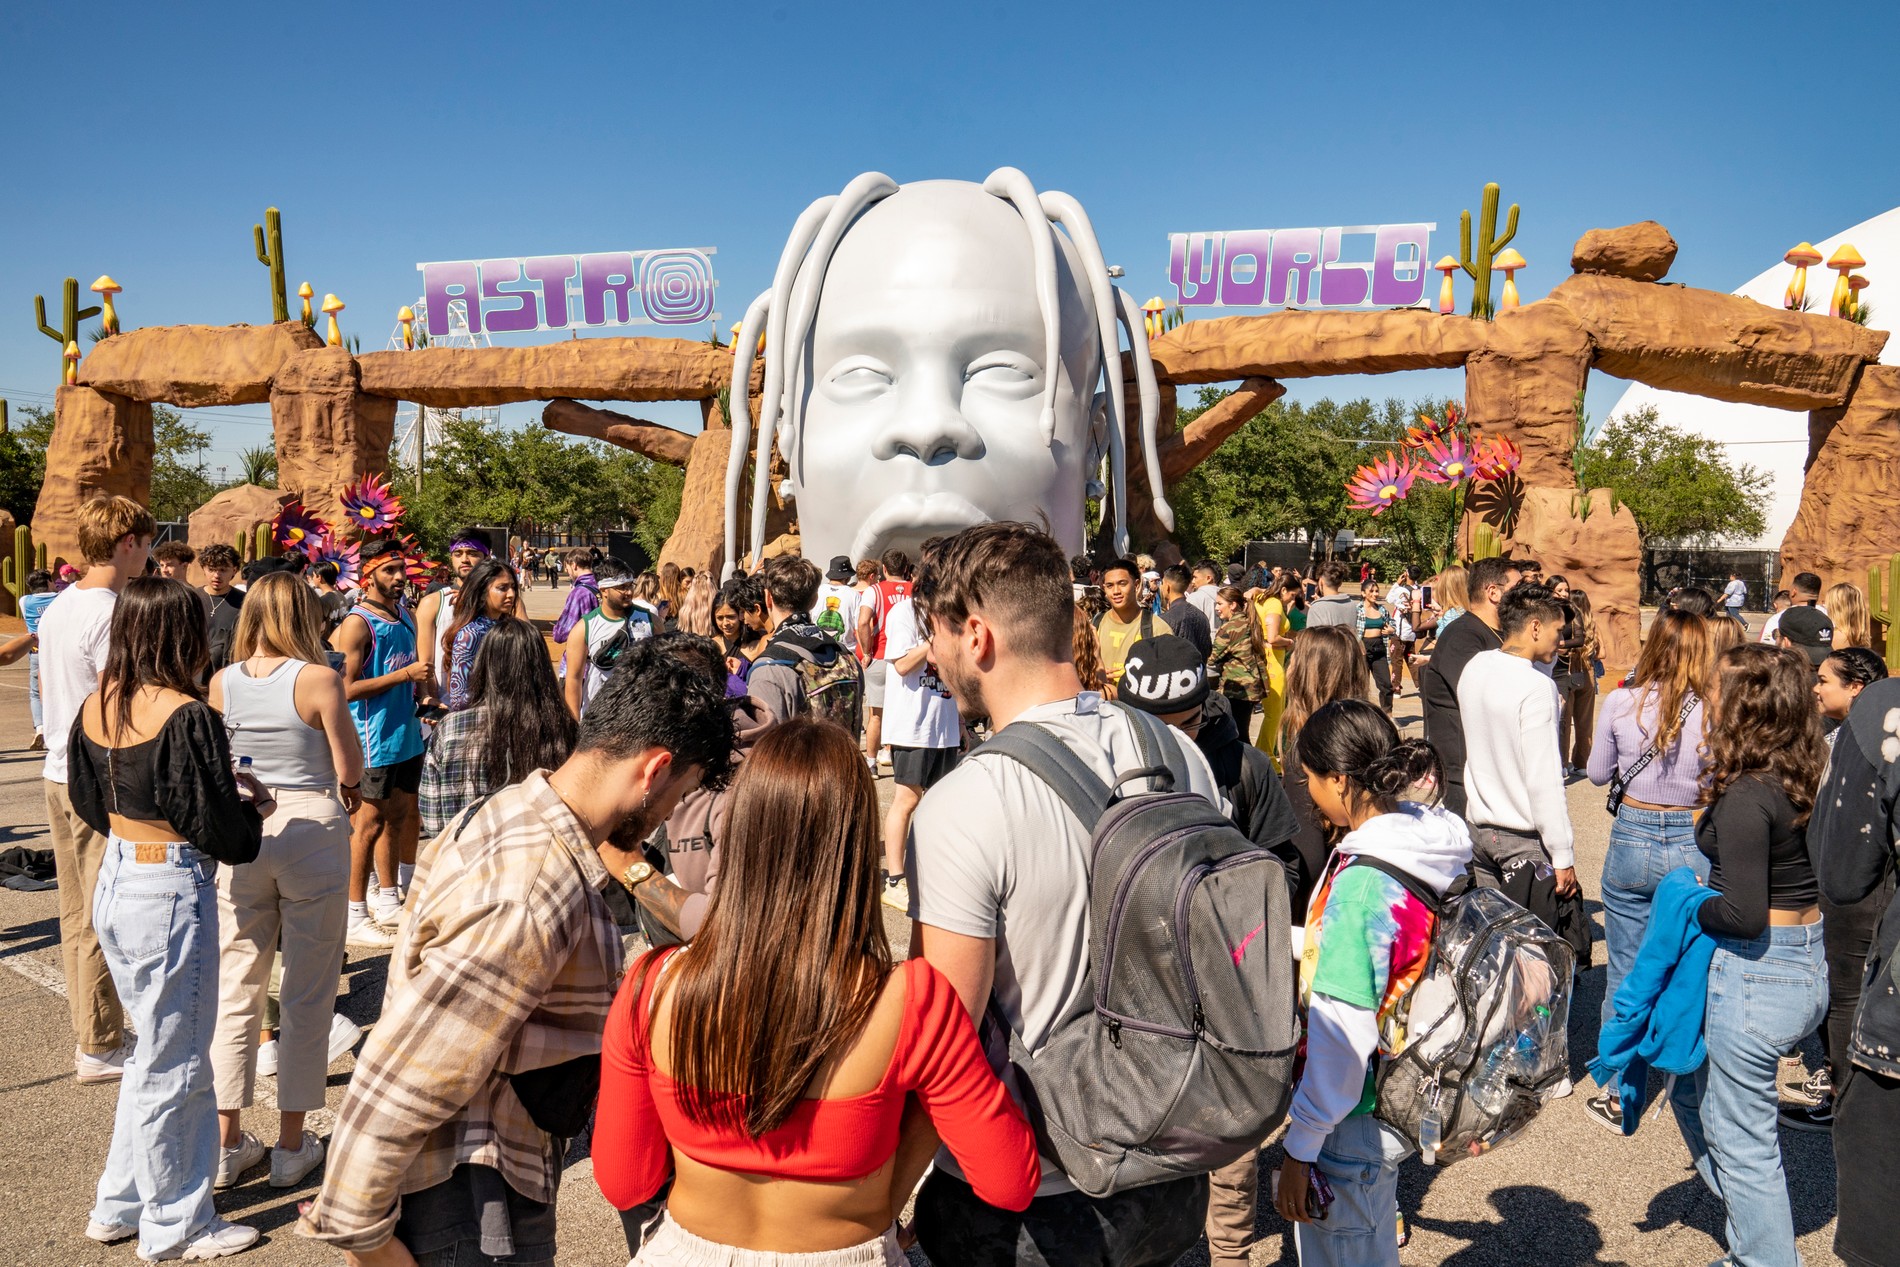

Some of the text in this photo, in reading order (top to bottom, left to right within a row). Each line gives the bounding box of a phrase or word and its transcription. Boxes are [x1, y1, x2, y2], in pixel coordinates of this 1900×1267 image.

[423, 223, 1430, 336] ASTRO WORLD
[920, 676, 936, 687] OUR
